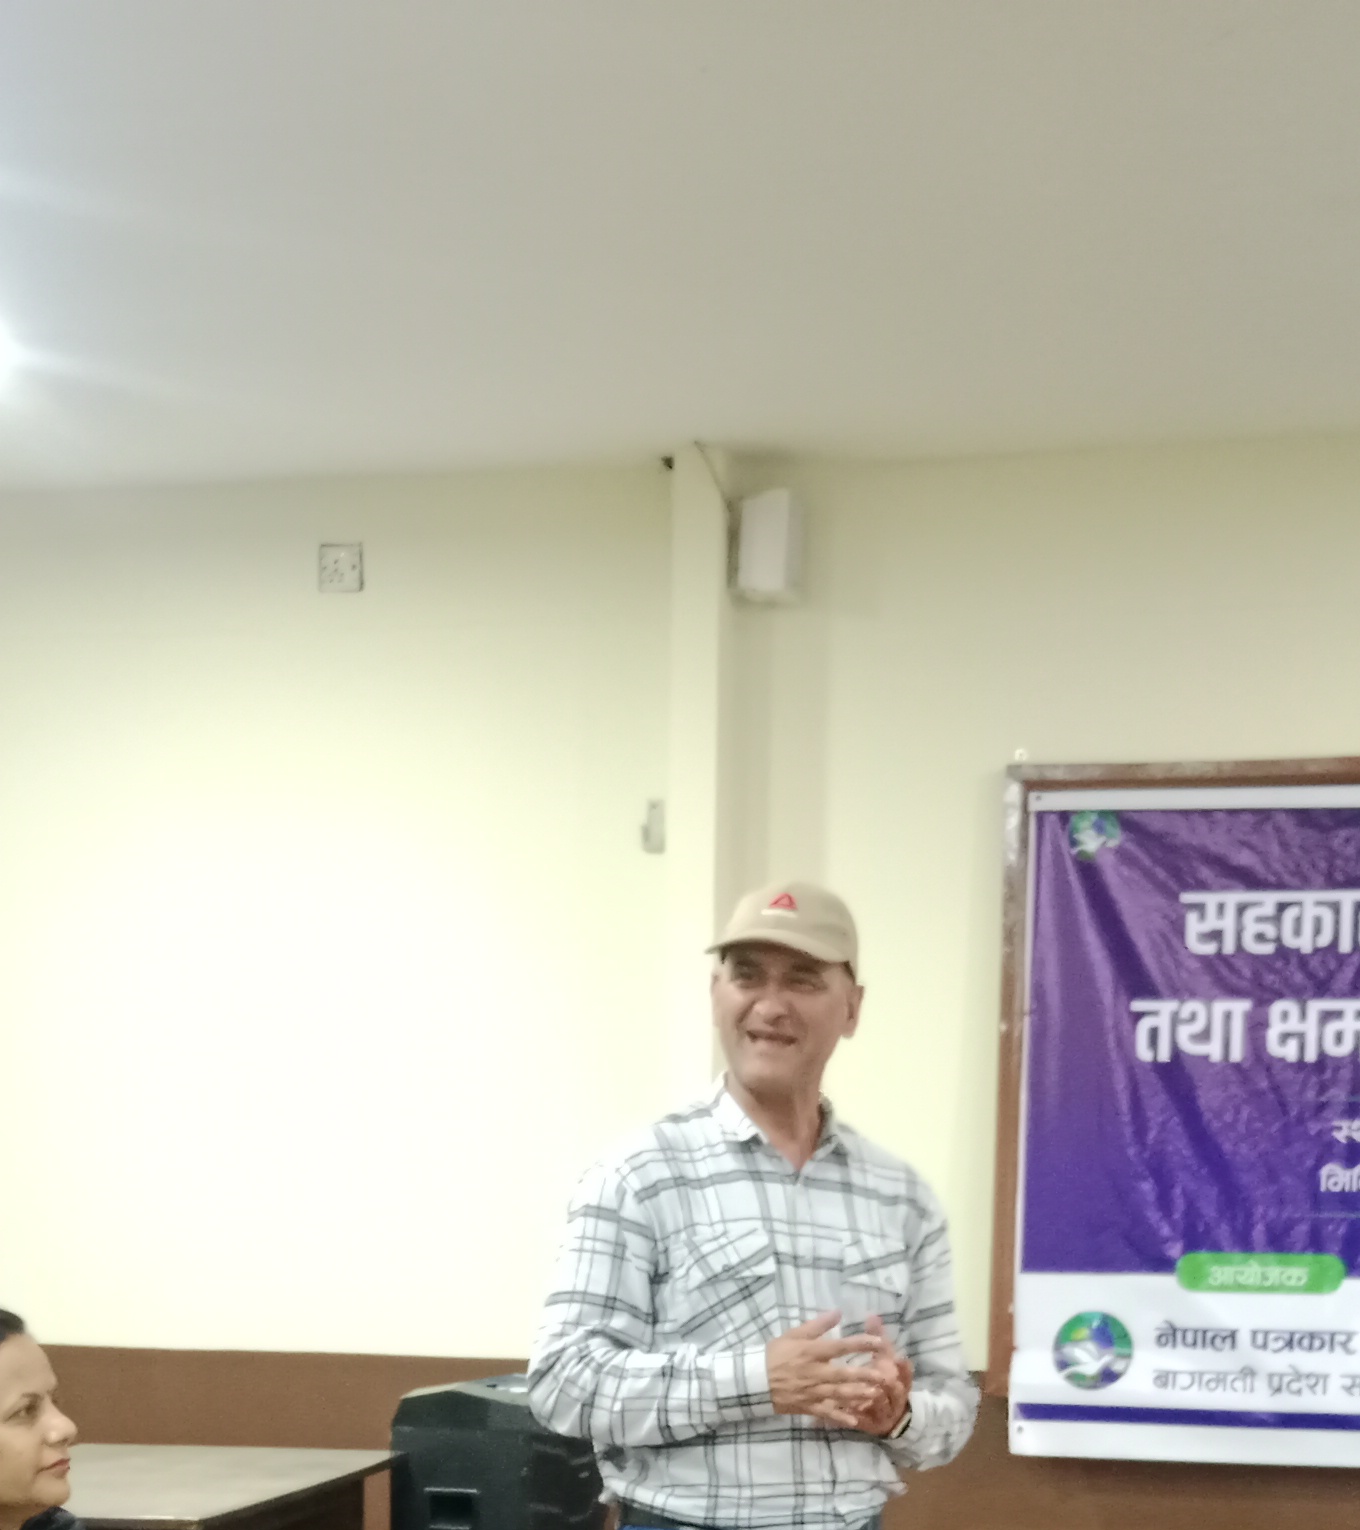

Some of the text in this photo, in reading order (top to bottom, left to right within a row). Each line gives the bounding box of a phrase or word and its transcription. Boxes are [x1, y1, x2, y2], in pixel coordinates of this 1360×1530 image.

[1130, 998, 1253, 1063] तथा
[1207, 1261, 1311, 1288] आयोजक
[1154, 1320, 1239, 1352] नेपाल
[1250, 1327, 1359, 1356] पत्रकार
[1152, 1365, 1257, 1395] बागमती
[1267, 1366, 1331, 1397] प्रदेश
